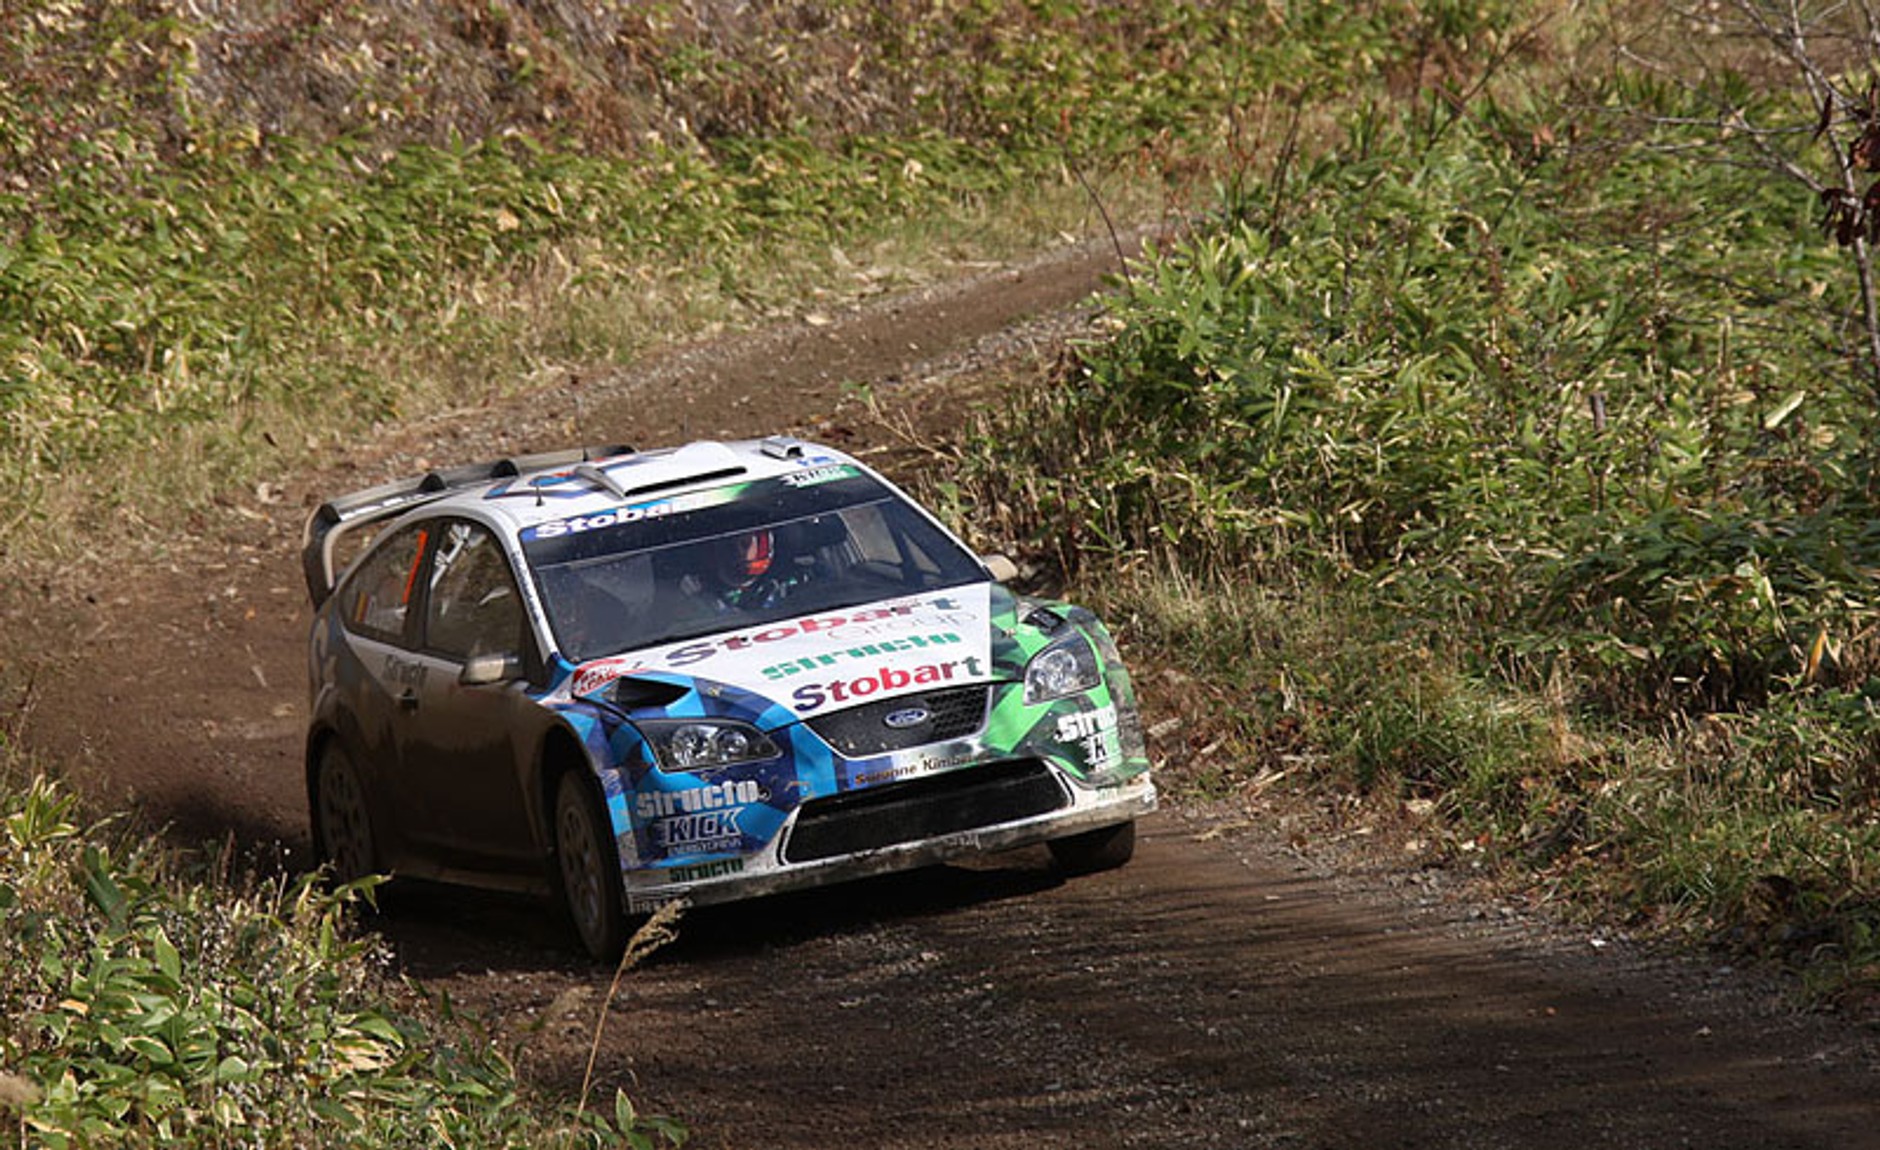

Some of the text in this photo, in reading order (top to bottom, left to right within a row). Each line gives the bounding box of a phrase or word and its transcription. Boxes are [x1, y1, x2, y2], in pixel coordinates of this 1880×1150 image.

[665, 597, 963, 667] Stobart
[792, 655, 984, 713] Stobart
[636, 780, 760, 818] structo
